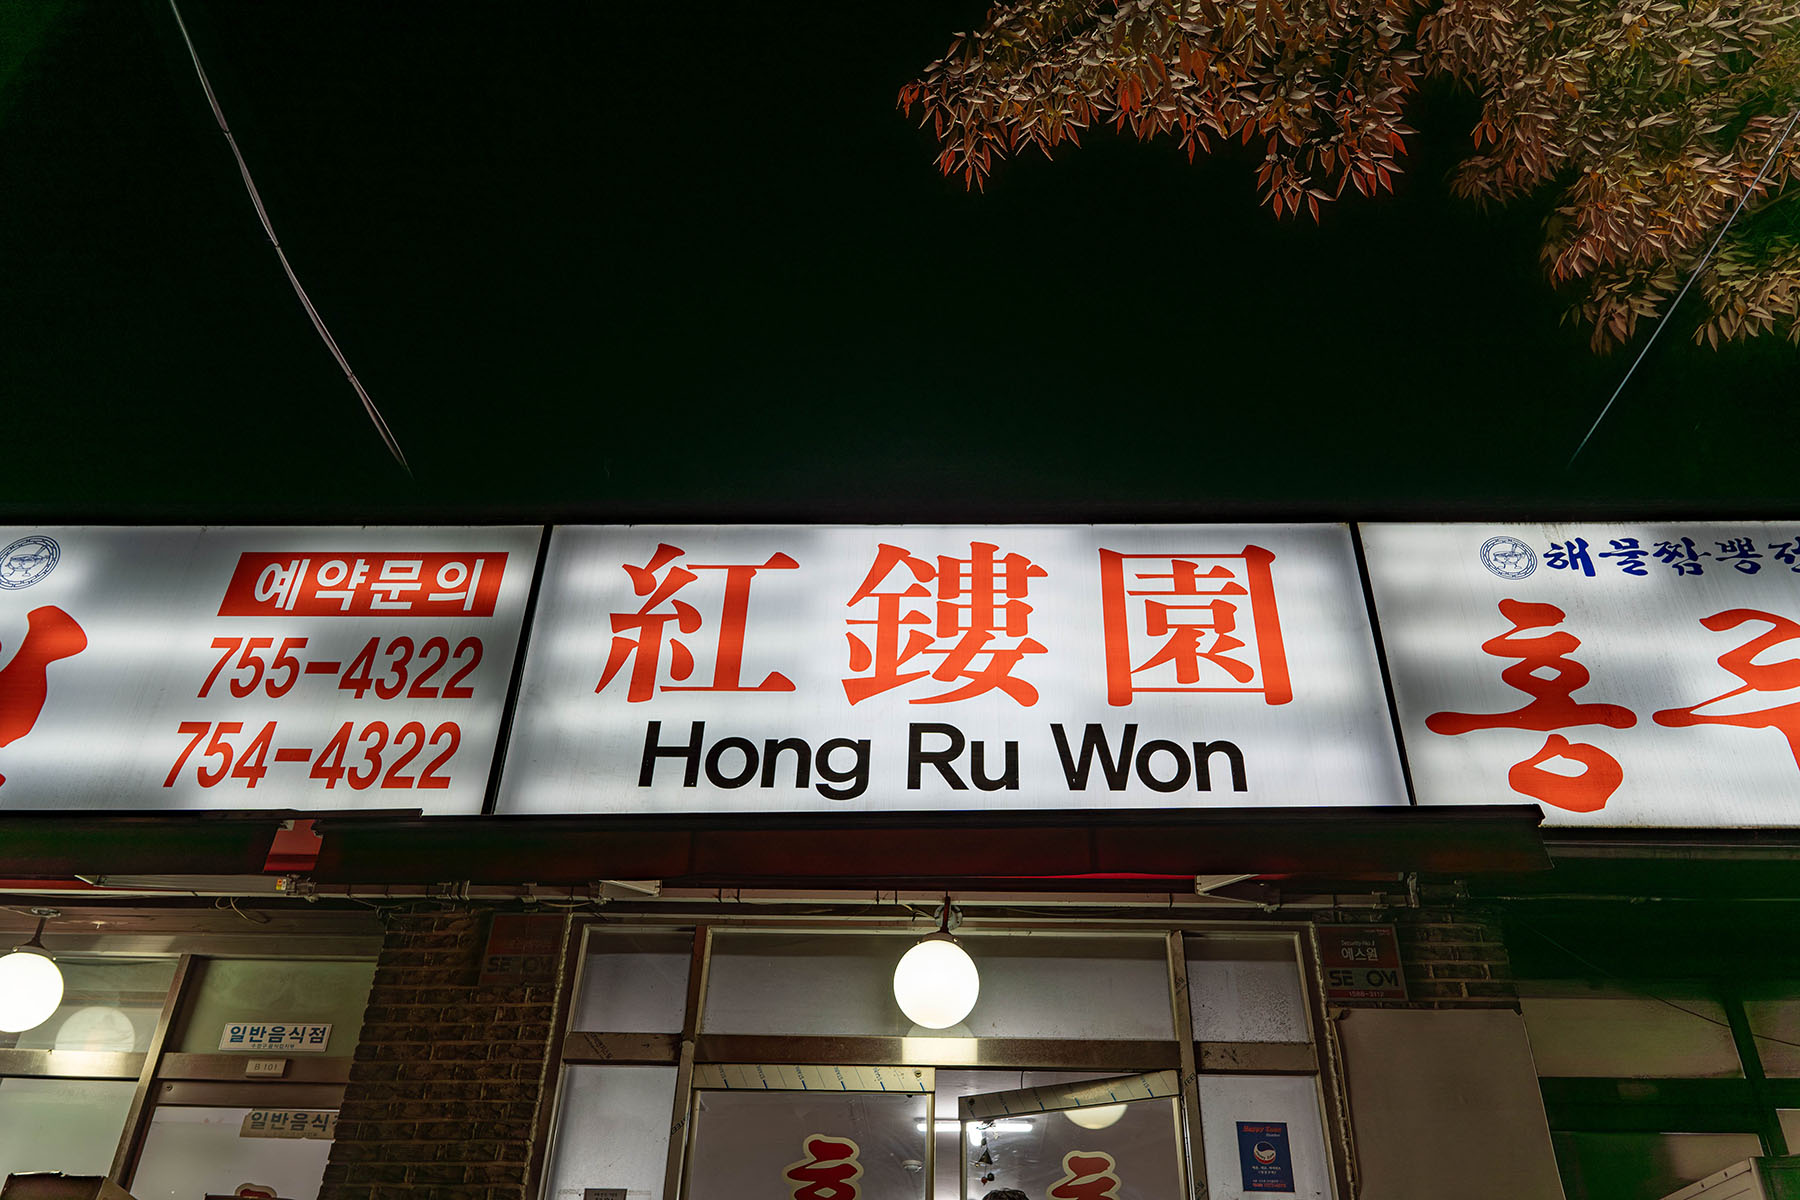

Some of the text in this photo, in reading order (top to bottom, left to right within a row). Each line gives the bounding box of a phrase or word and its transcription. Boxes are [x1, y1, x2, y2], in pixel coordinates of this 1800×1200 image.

[254, 558, 486, 611] 예약문의
[595, 541, 1293, 707] 紅鏤園
[197, 636, 483, 700] 755-4322
[163, 721, 462, 790] 754-4322
[638, 721, 1247, 800] Hong Ru Won
[1341, 947, 1378, 961] 에스원
[229, 1026, 327, 1044] 일반음식점
[251, 1111, 337, 1131] 일반음식
